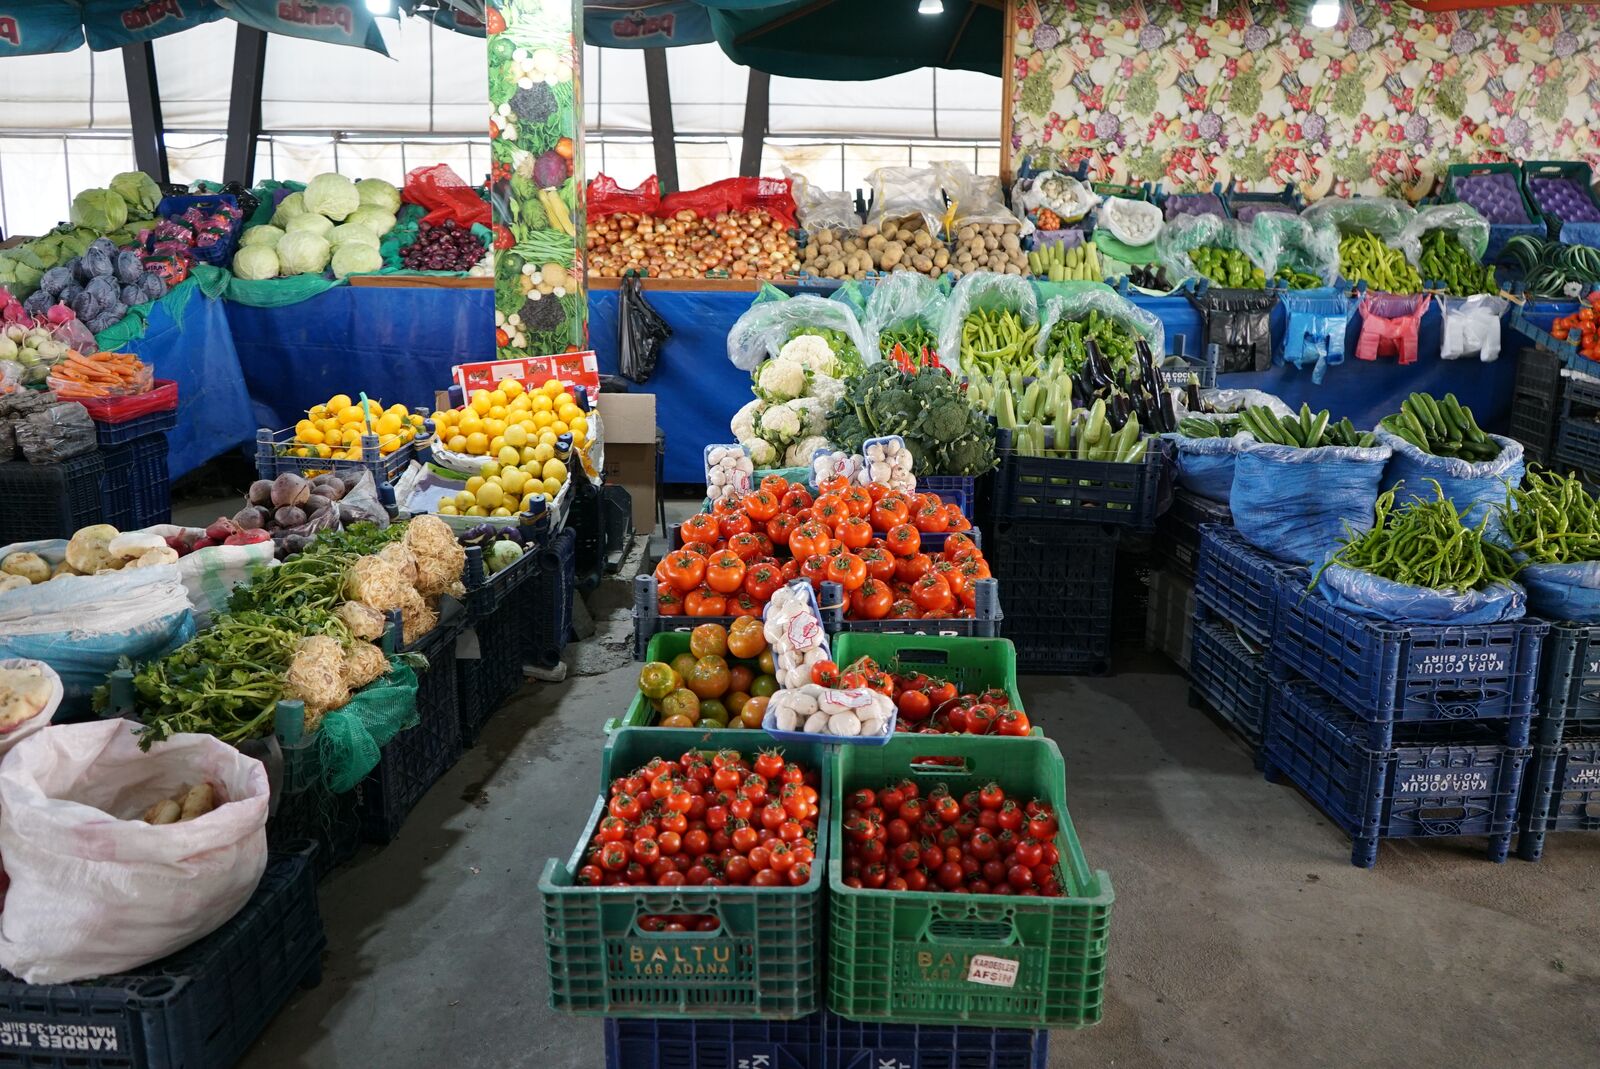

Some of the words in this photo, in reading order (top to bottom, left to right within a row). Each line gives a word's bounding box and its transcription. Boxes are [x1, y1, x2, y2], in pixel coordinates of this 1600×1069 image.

[1462, 653, 1497, 662] NO:16
[1467, 660, 1504, 672] KARA
[1446, 772, 1480, 781] NO:16
[1401, 780, 1448, 792] ÇOCUK
[1453, 780, 1487, 791] KARA
[630, 945, 730, 962] BALTU
[635, 963, 663, 975] 168
[671, 963, 729, 975] ADANA
[89, 1026, 117, 1037] HAL
